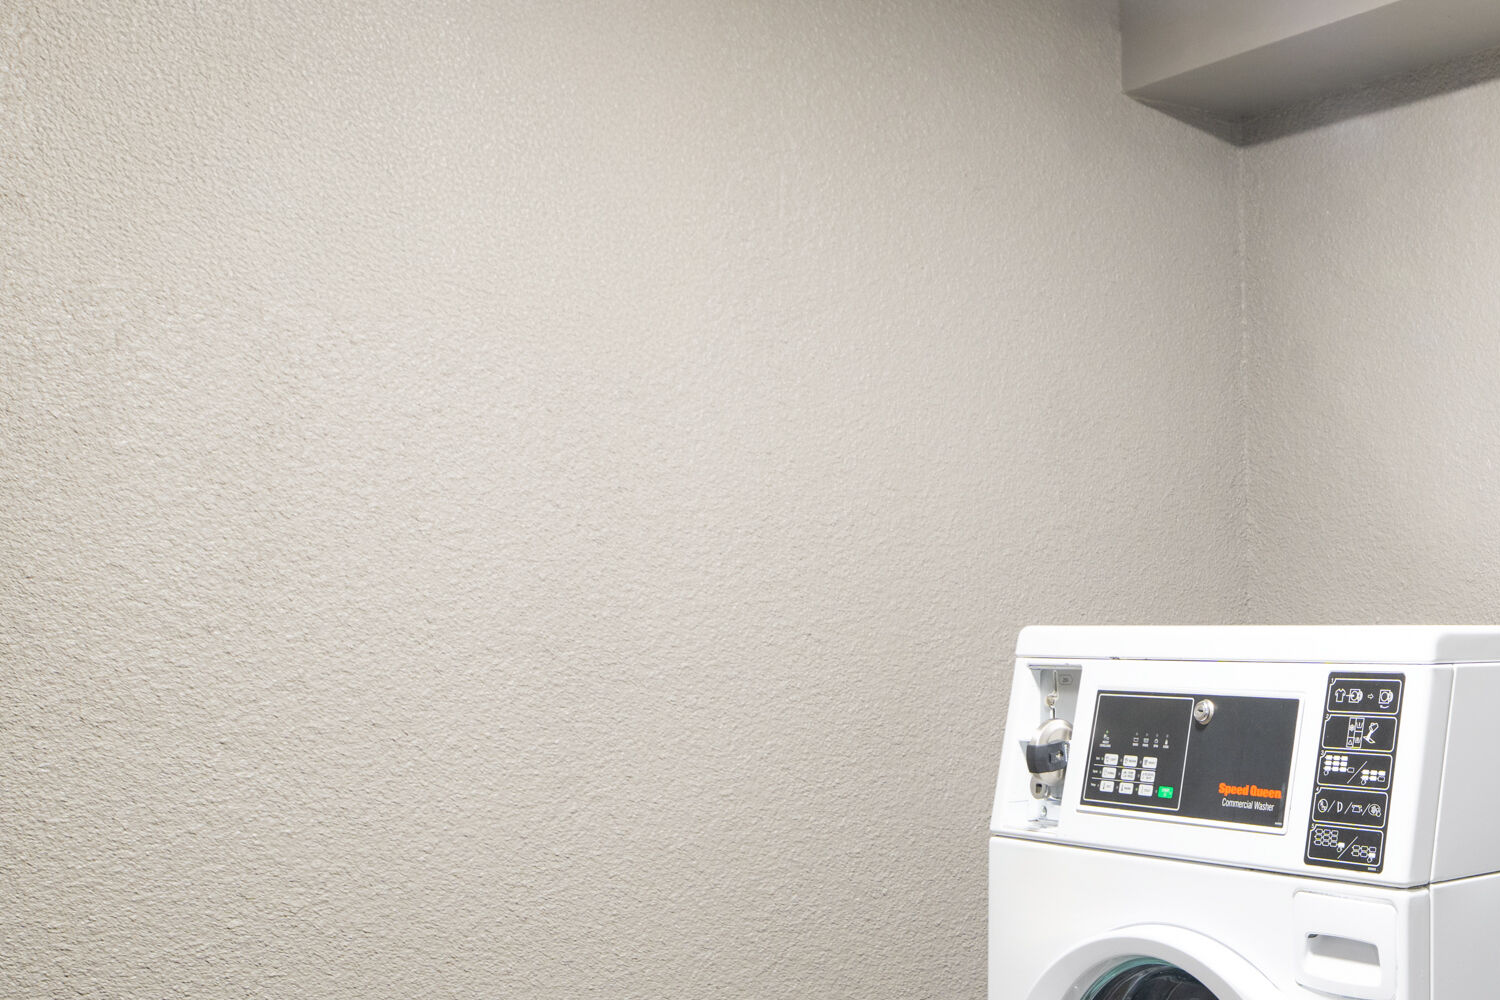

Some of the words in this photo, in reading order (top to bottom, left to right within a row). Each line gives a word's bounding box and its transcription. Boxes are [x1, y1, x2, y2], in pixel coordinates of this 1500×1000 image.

[1218, 782, 1250, 796] Speed
[1250, 784, 1282, 799] Queen
[1222, 798, 1253, 810] Commercial
[1254, 801, 1275, 811] Washer
